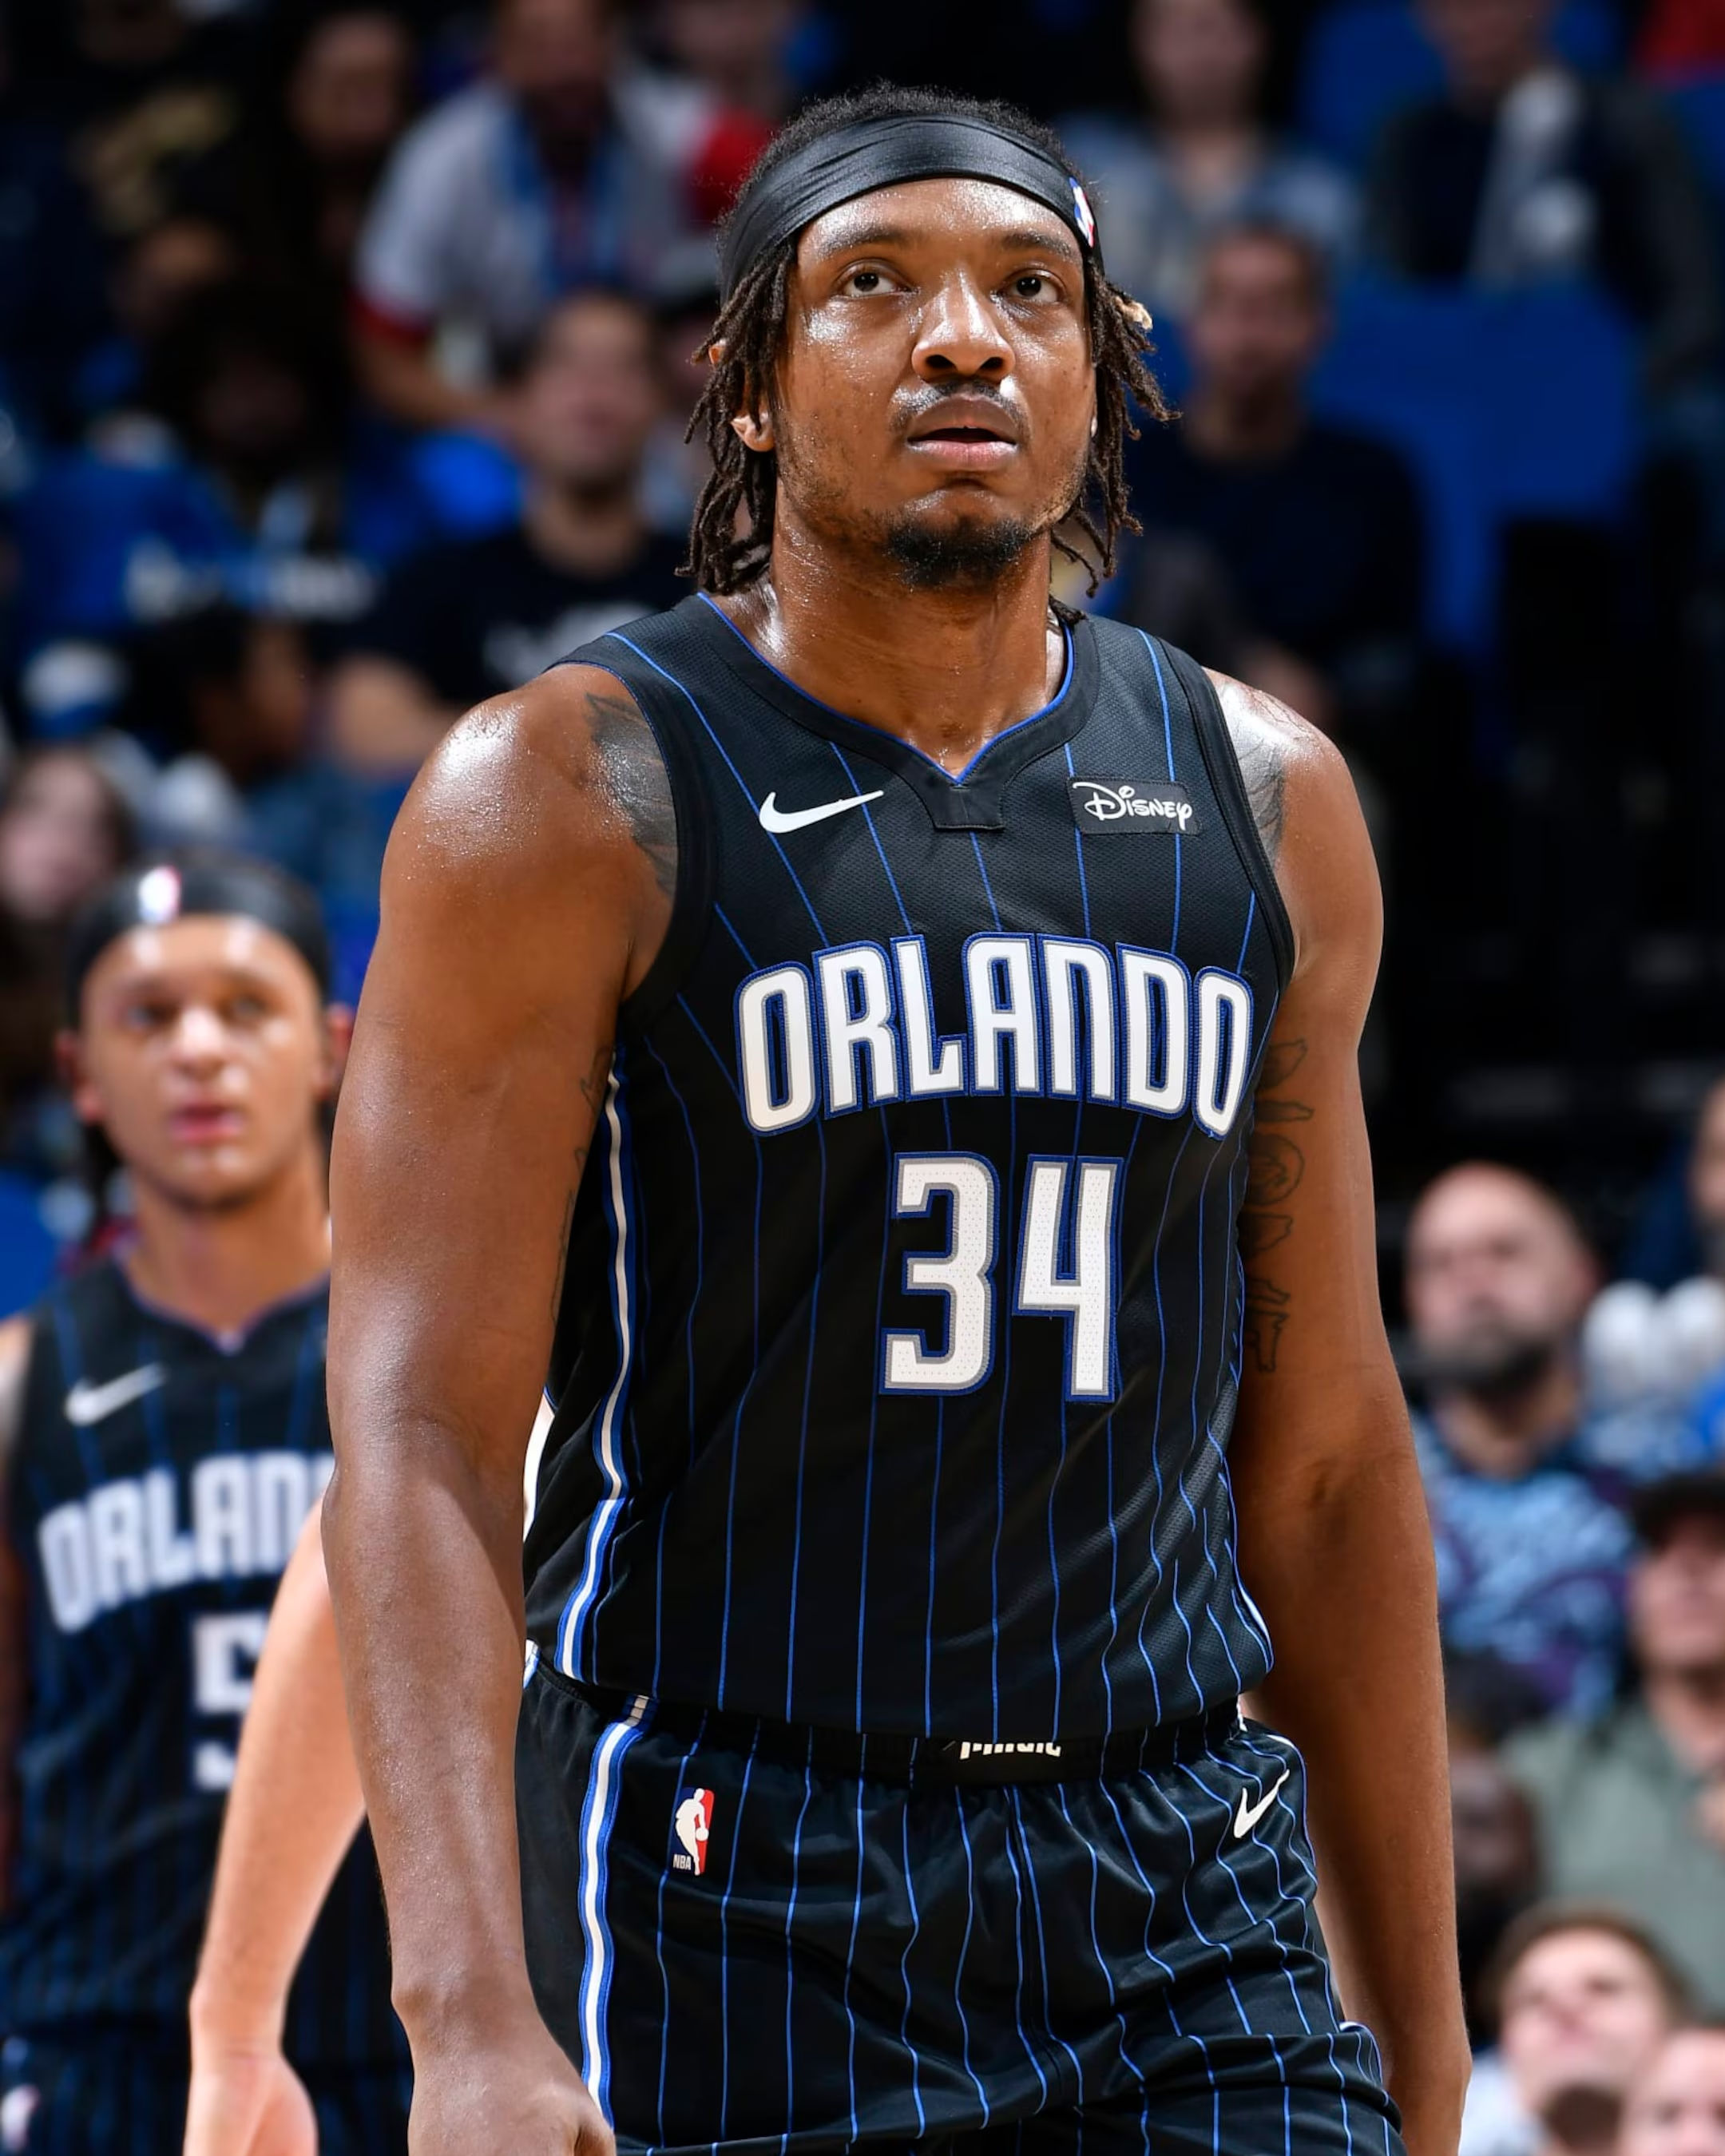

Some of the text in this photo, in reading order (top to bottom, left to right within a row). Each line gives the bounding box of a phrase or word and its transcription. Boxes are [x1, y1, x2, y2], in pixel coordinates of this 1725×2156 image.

[734, 932, 1253, 1140] ORLANDO
[879, 1151, 1124, 1403] 34
[672, 1853, 692, 1870] NBA
